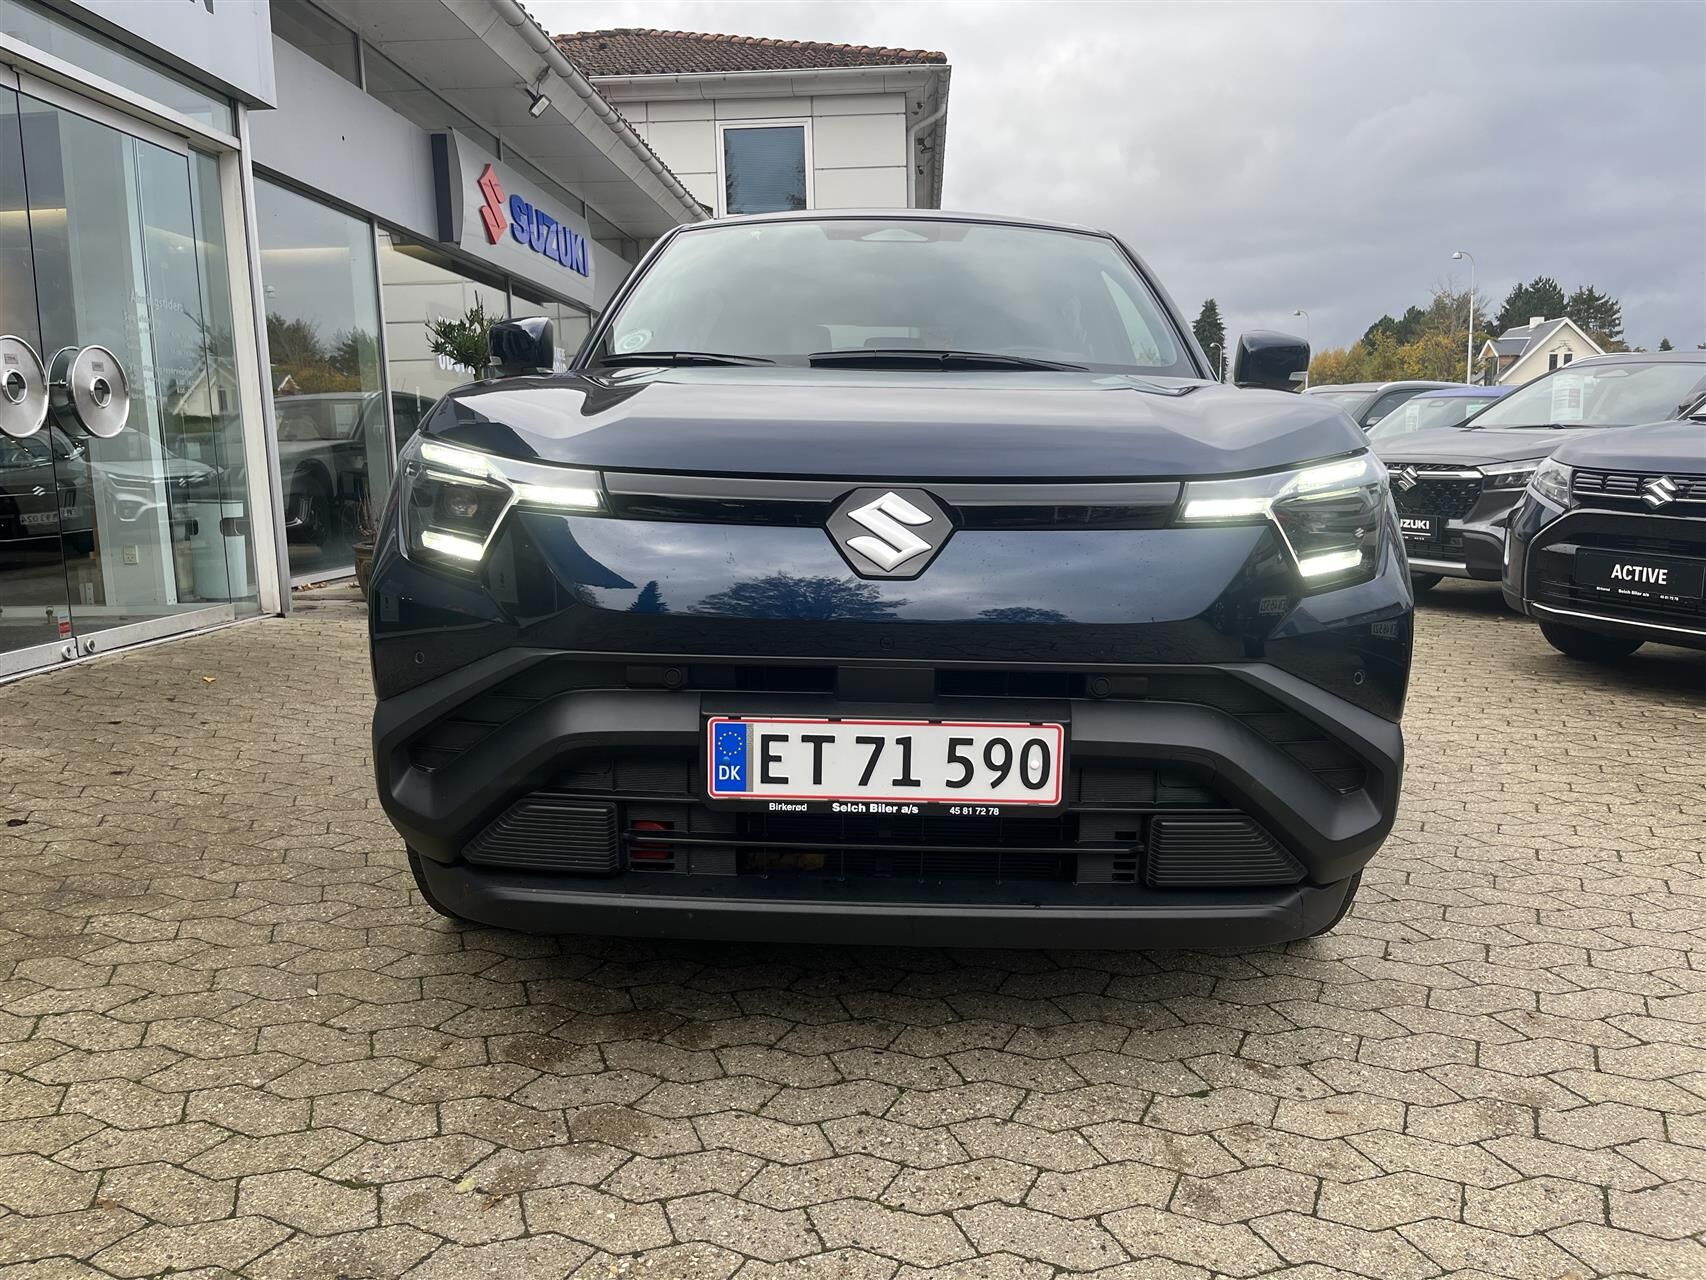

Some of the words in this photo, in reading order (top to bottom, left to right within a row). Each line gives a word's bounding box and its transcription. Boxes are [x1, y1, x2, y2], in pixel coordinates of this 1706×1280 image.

[509, 194, 589, 277] SUZUKI
[1611, 564, 1668, 585] ACTIVE
[760, 734, 836, 785] ET
[856, 736, 921, 787] 71
[946, 737, 1050, 790] 590
[718, 765, 741, 781] DK
[768, 802, 808, 812] Birkerød
[832, 803, 866, 813] Selch
[869, 803, 899, 814] Biler
[901, 804, 919, 814] a/s
[949, 806, 961, 815] 45
[962, 807, 973, 815] 81
[975, 807, 986, 816] 72
[988, 807, 1000, 816] 78
